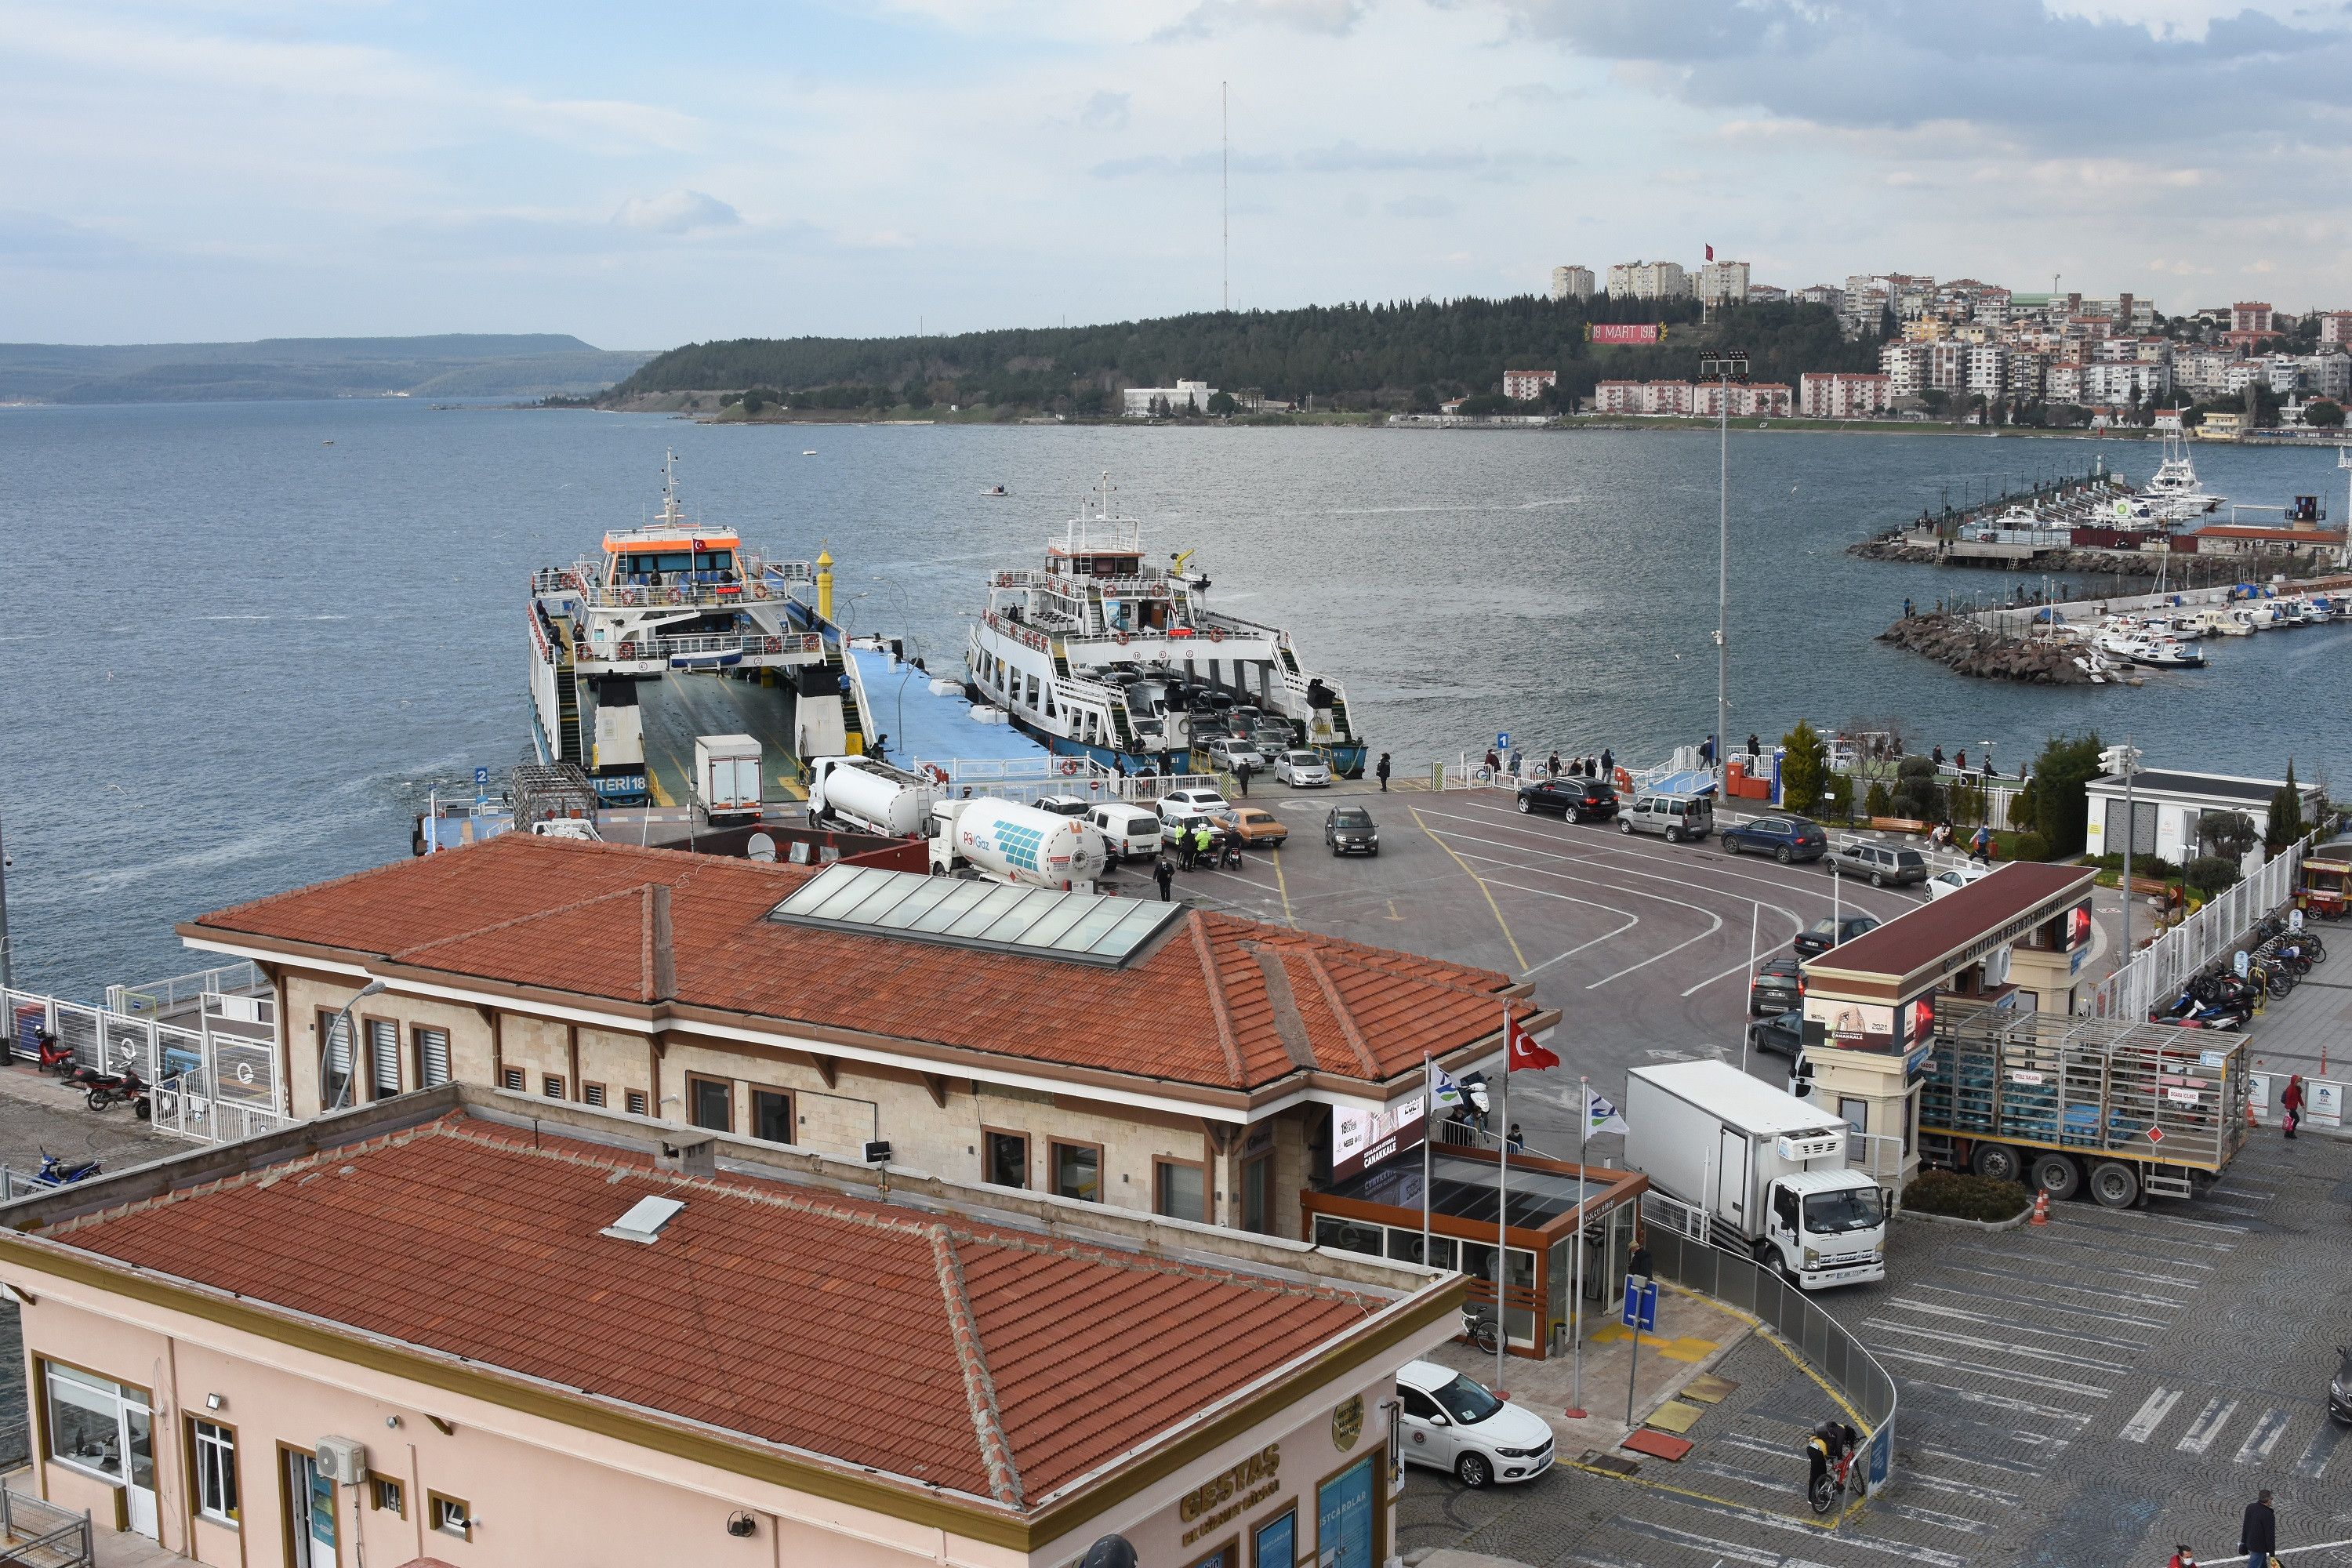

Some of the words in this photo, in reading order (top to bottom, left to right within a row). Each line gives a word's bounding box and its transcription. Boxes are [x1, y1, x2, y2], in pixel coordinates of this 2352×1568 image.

[1592, 325, 1601, 339] 18
[1605, 325, 1636, 339] MART
[1640, 325, 1657, 339] 1915
[1500, 735, 1506, 746] 1
[477, 771, 486, 782] 2
[631, 777, 645, 789] 18
[1584, 1208, 1600, 1221] YOLCU
[1180, 1443, 1280, 1523] GESTAŞ
